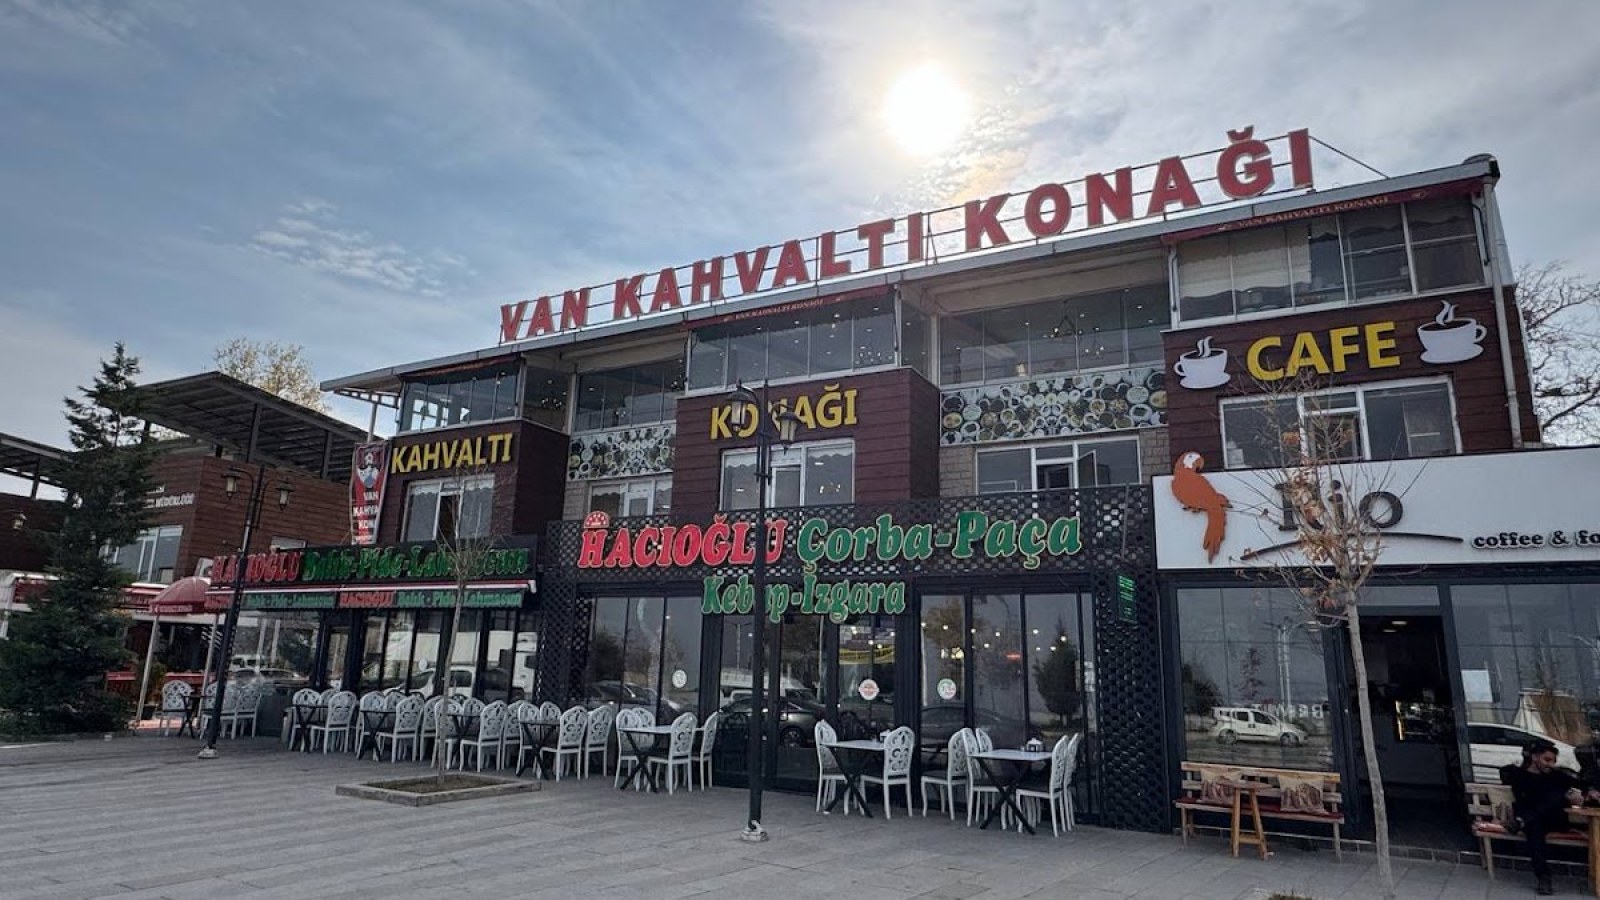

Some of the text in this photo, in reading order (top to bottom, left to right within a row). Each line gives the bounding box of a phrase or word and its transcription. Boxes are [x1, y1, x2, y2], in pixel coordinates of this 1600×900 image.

[500, 125, 1314, 342] VAN KAHVALTI KONAĞI
[1247, 321, 1400, 381] CAFE
[391, 432, 513, 474] KAHVALTI
[578, 510, 1083, 573] HACIOĞLU Çorba-Paça
[1473, 531, 1545, 549] coffee
[1551, 529, 1570, 546] &
